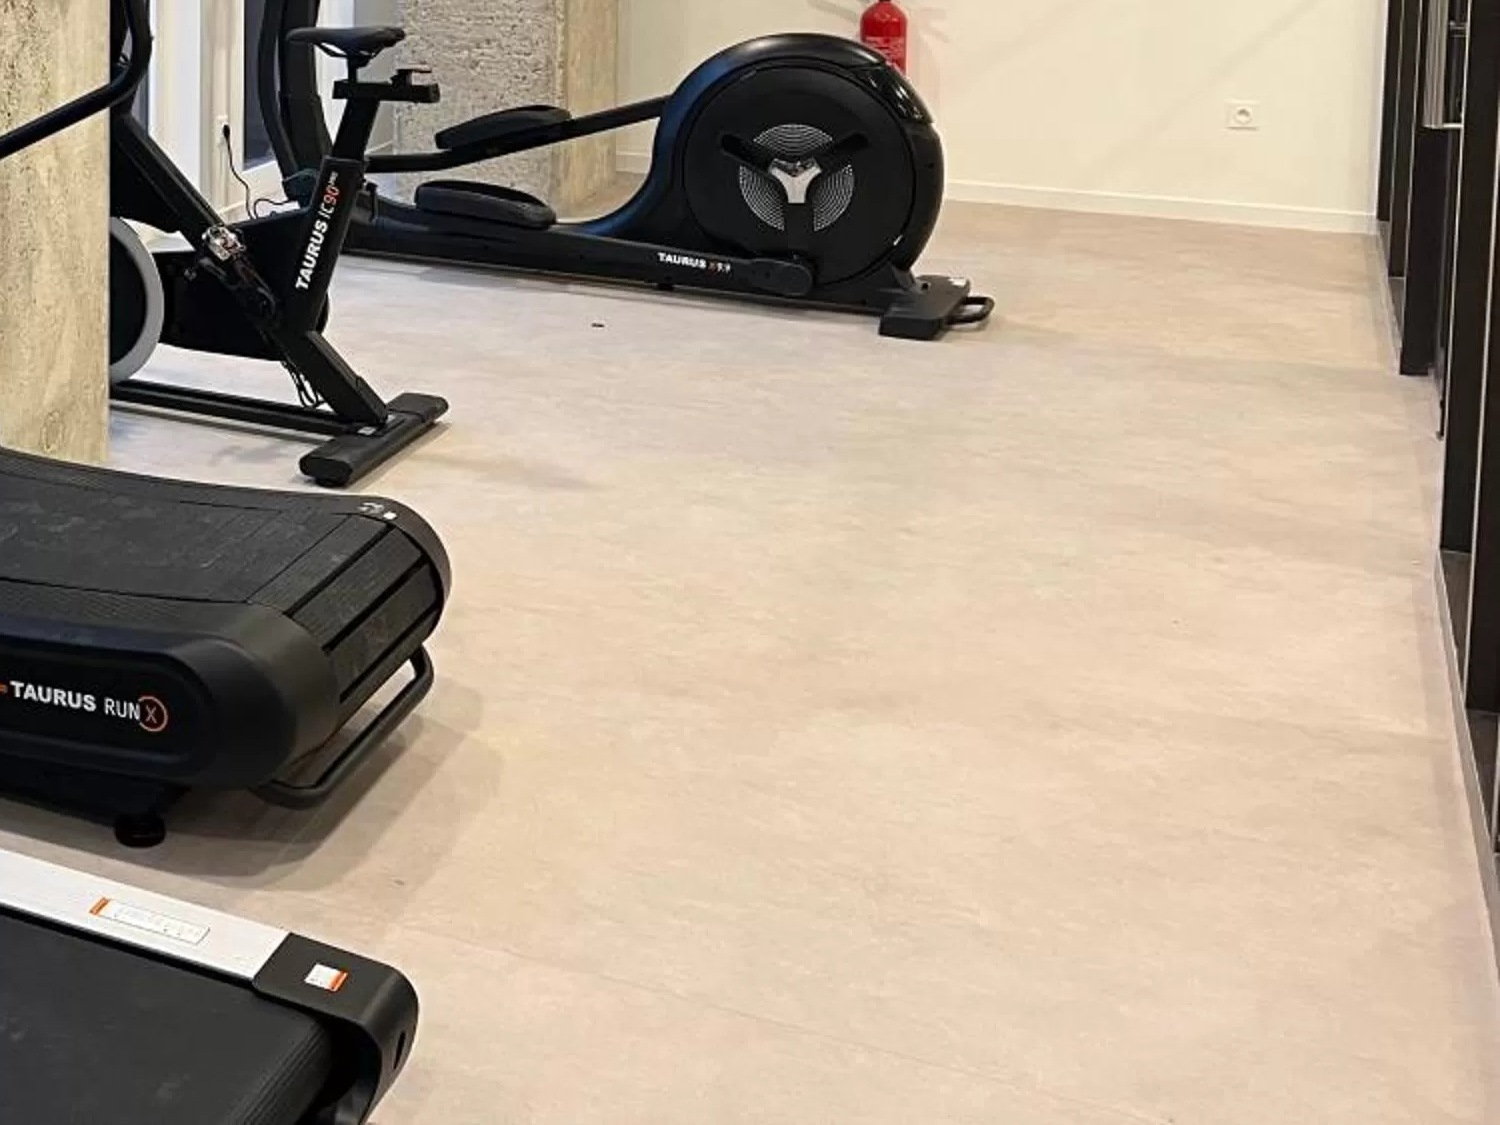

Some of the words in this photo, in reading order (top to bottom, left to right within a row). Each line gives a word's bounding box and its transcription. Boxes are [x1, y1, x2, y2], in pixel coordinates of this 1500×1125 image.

[295, 219, 329, 290] TAURUS
[657, 252, 706, 269] TAURUS
[9, 680, 97, 712] TAURUS
